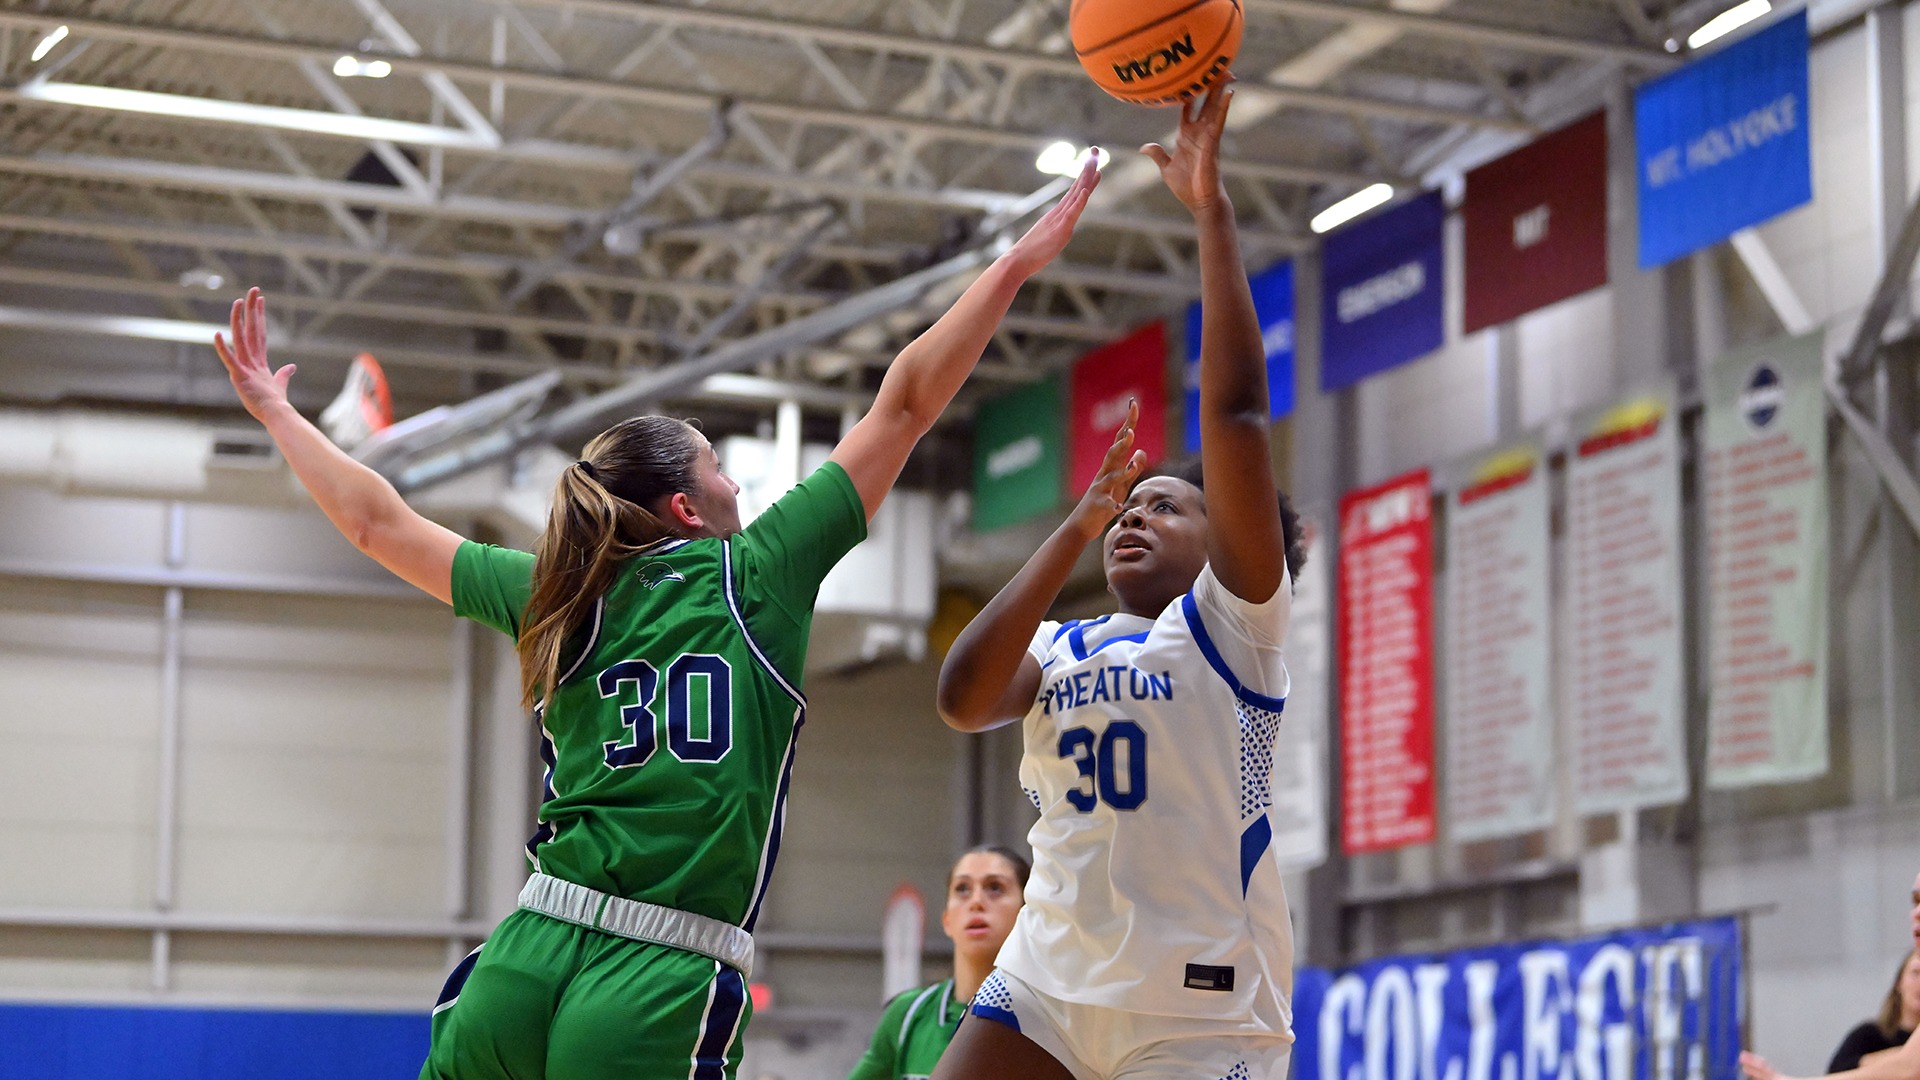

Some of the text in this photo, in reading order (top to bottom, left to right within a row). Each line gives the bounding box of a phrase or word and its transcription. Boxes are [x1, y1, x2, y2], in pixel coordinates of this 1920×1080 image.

[1112, 33, 1196, 84] NCAA
[1686, 93, 1797, 173] HOLYOKE
[597, 653, 733, 771] 30
[1057, 719, 1148, 814] 30
